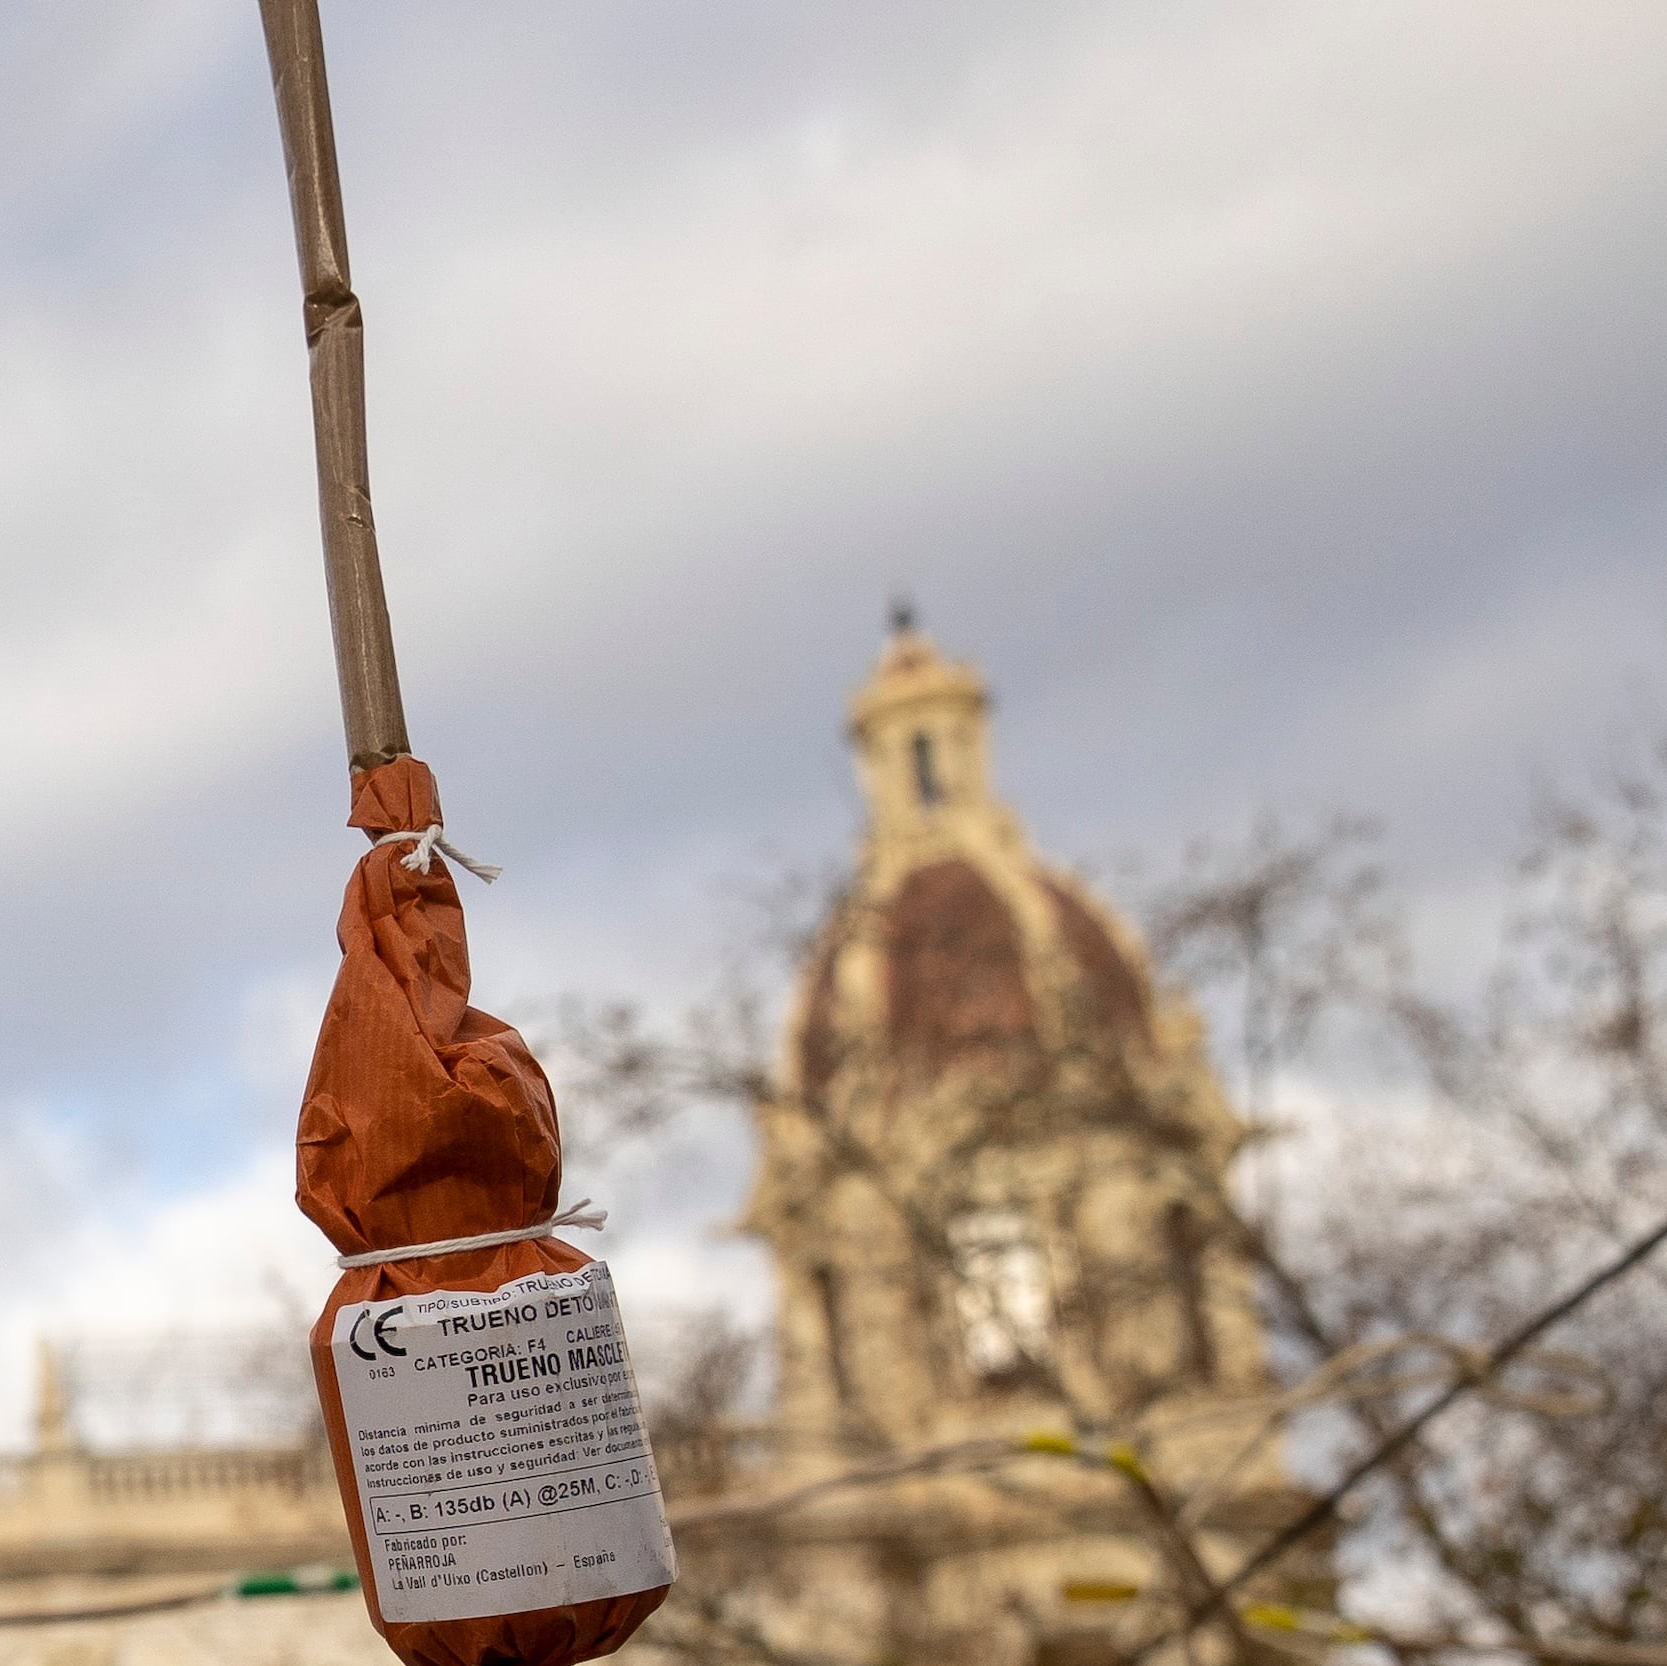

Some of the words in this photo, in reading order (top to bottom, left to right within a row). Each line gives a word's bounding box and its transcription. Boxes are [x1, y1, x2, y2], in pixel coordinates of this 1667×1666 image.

[436, 1304, 537, 1337] TRUENO
[414, 1343, 522, 1372] CATEGORIA:
[527, 1337, 547, 1353] F4
[464, 1353, 561, 1389] TRUENO
[368, 1366, 396, 1380] 0163
[467, 1390, 505, 1407] Para
[510, 1386, 540, 1400] uso
[545, 1373, 608, 1395] exclusivo
[358, 1425, 407, 1442] Distancia
[469, 1414, 487, 1426] de
[494, 1401, 562, 1422] seguridad
[569, 1400, 576, 1409] a
[581, 1396, 598, 1408] ser
[360, 1446, 376, 1458] los
[378, 1441, 409, 1457] datos
[413, 1439, 428, 1452] de
[432, 1430, 495, 1451] producto
[500, 1412, 589, 1438] suministrados
[591, 1411, 609, 1425] por
[365, 1460, 399, 1474] acorde
[402, 1457, 425, 1470] con
[428, 1454, 447, 1467] las
[450, 1439, 544, 1464] instrucciones
[548, 1429, 595, 1448] escritas
[597, 1429, 604, 1442] y
[446, 1469, 463, 1481] de
[467, 1466, 493, 1478] uso
[498, 1463, 505, 1475] y
[582, 1444, 602, 1458] Ver
[375, 1506, 391, 1523] A:
[409, 1504, 429, 1521] B:
[434, 1494, 495, 1518] 135db
[502, 1488, 531, 1511] (A)
[605, 1472, 622, 1490] C:
[384, 1536, 437, 1552] Fabricado
[442, 1534, 467, 1550] por:
[388, 1552, 457, 1572] PEÑARROJA
[405, 1574, 426, 1590] Vall
[475, 1561, 548, 1585] (Castellon)
[573, 1549, 616, 1569] España
